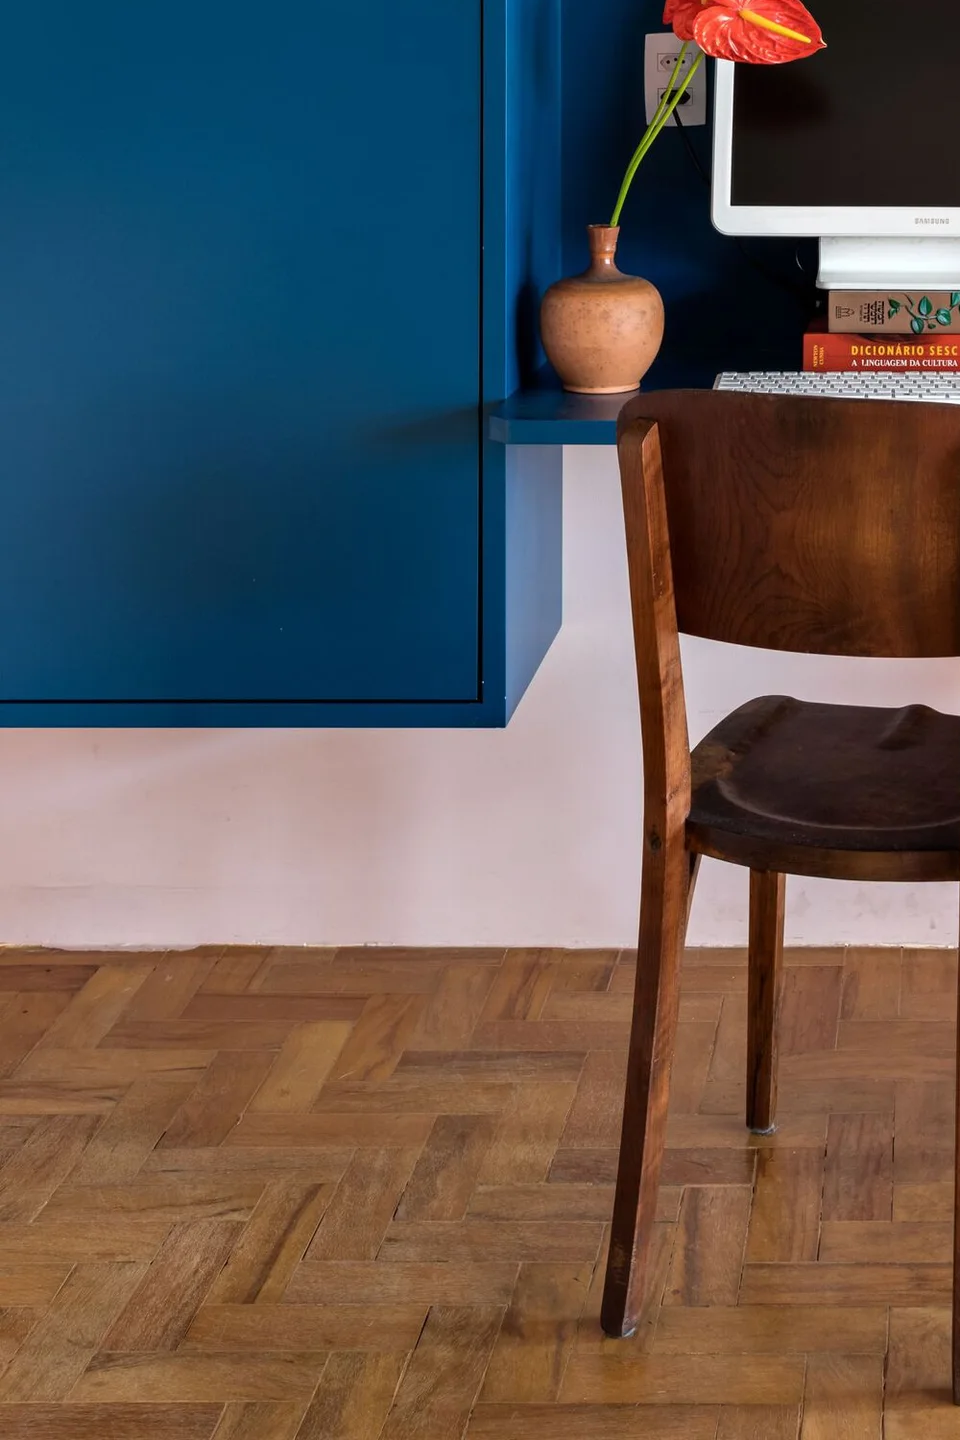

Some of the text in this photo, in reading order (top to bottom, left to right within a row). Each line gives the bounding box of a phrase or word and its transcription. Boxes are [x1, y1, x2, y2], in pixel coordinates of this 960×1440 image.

[915, 217, 951, 225] SAMSUNG
[850, 342, 958, 356] DICIONÁRIO SESC
[861, 358, 907, 367] LINGUAGEM
[909, 358, 920, 367] DA
[921, 358, 958, 367] CULTURA
